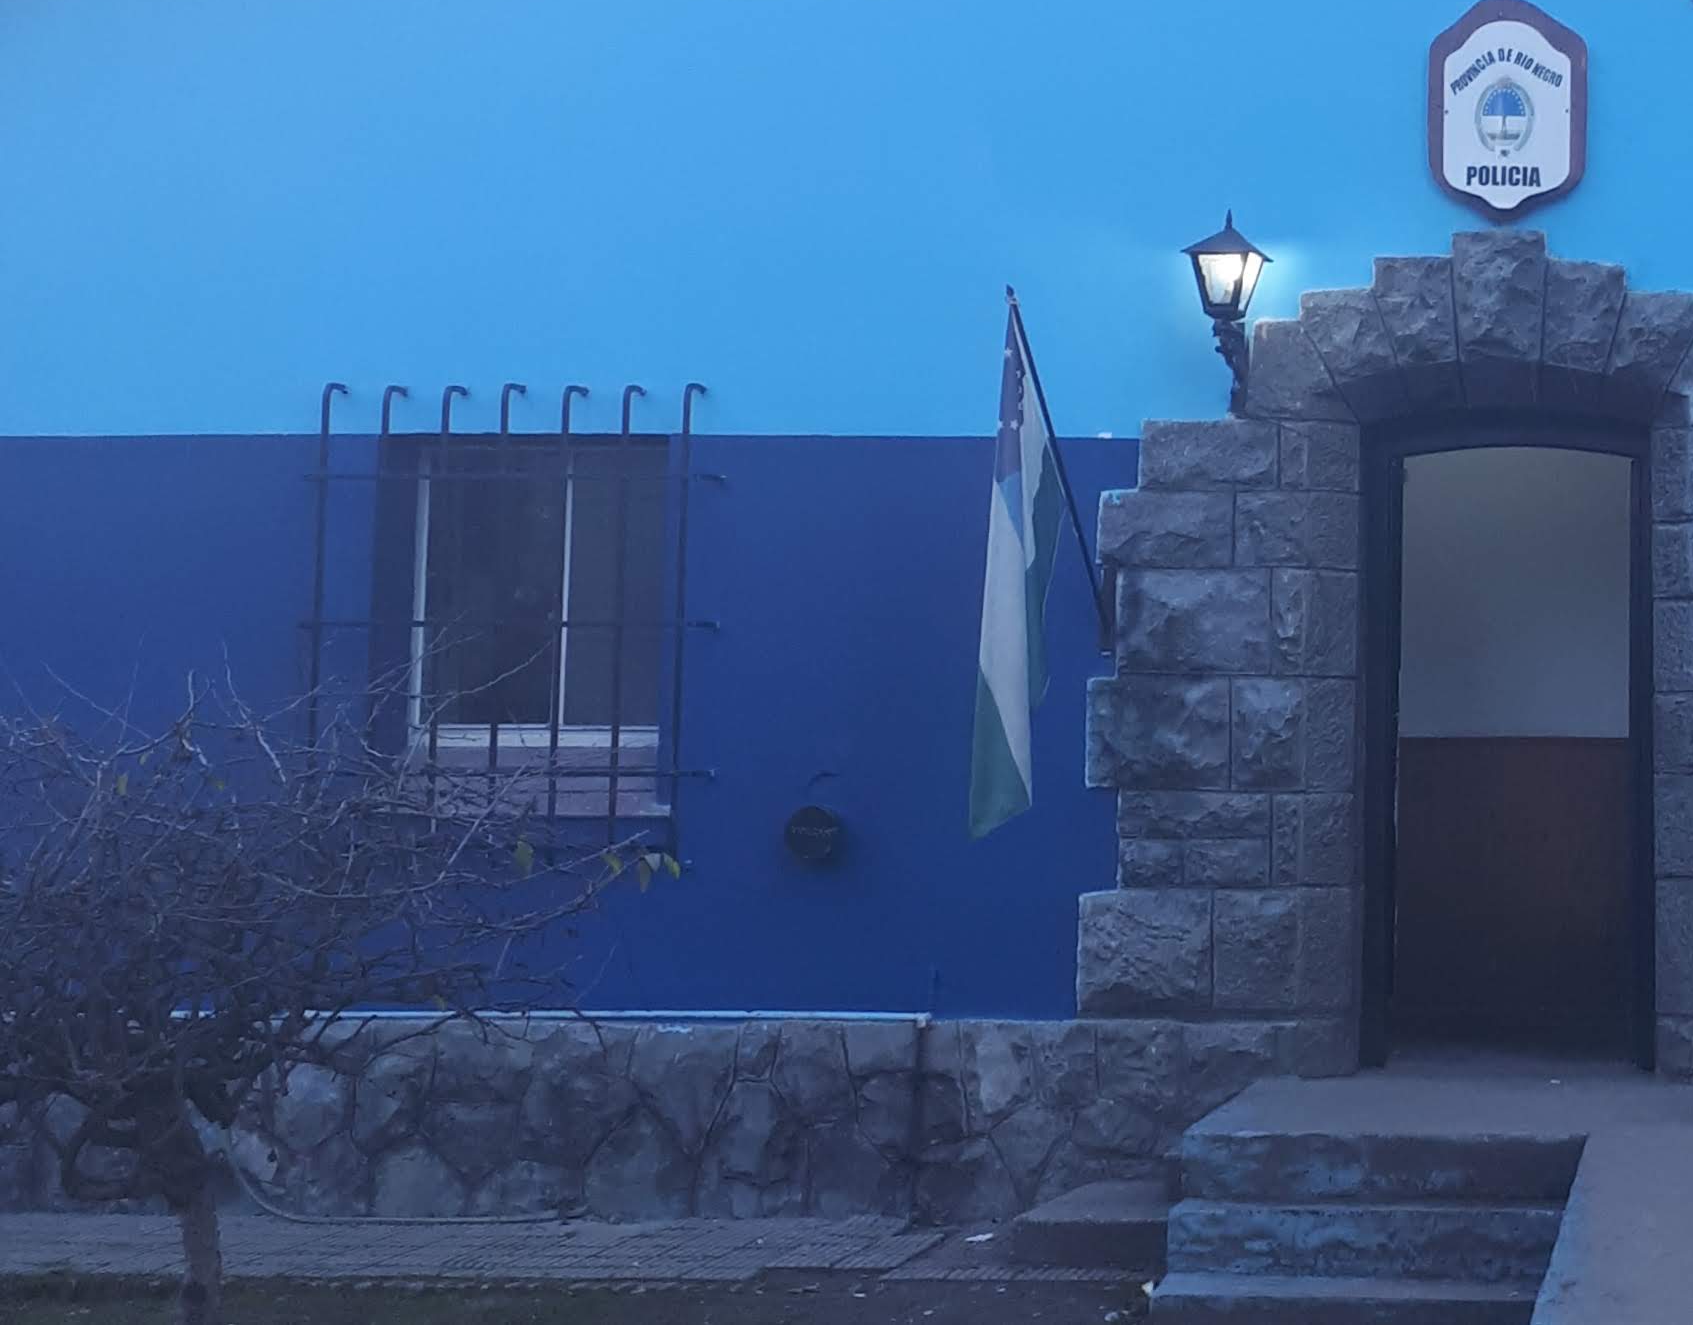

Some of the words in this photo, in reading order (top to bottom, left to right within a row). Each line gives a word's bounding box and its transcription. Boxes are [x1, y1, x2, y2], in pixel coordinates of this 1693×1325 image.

[1449, 50, 1496, 95] PROVINCIA
[1497, 47, 1513, 63] DE
[1513, 51, 1535, 71] RIO
[1531, 62, 1563, 88] NEGRO
[1466, 166, 1542, 187] POLICIA
